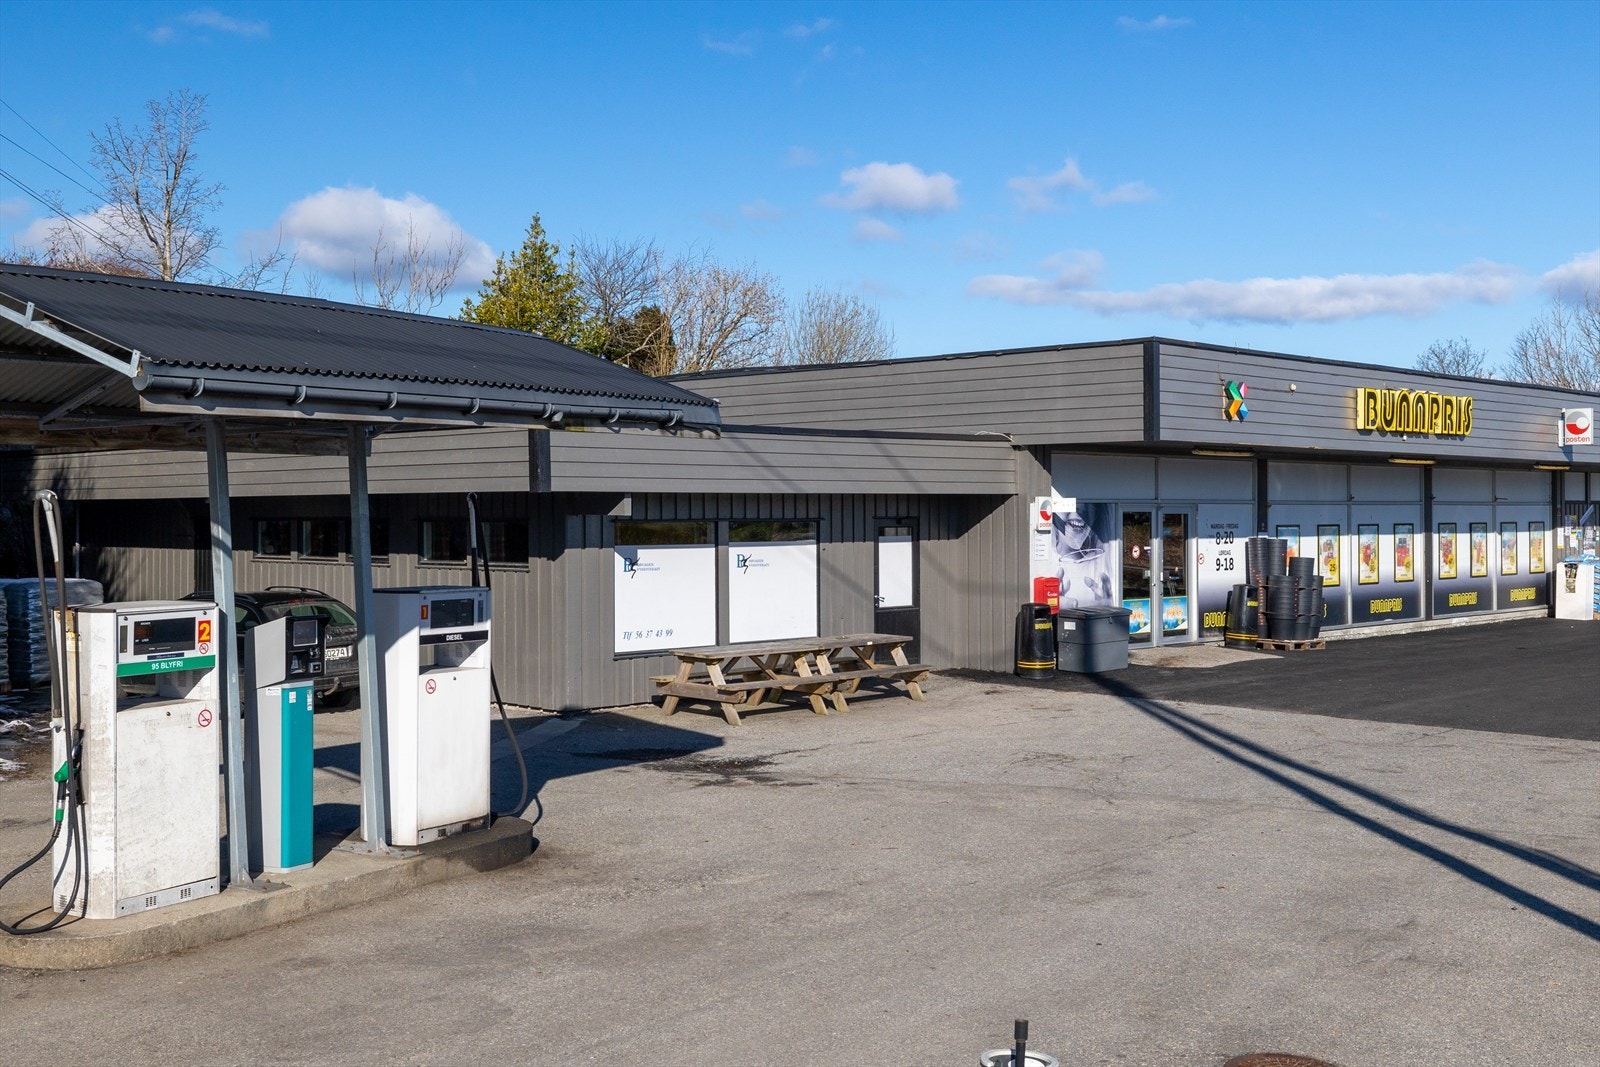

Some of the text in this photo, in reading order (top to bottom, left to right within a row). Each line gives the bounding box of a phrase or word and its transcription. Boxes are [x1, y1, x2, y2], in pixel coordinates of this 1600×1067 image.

[1363, 387, 1473, 436] BUNNPRIS
[1448, 592, 1478, 607] BUNNPRIS
[1509, 587, 1536, 602] BUNNPRIS
[422, 606, 427, 618] 1
[1369, 598, 1403, 613] BUNNPRIS
[199, 622, 210, 641] 2
[446, 633, 463, 641] DIESEL
[623, 628, 673, 641] Tlf 56 37 43 99
[151, 660, 184, 671] 95 BLYFRI
